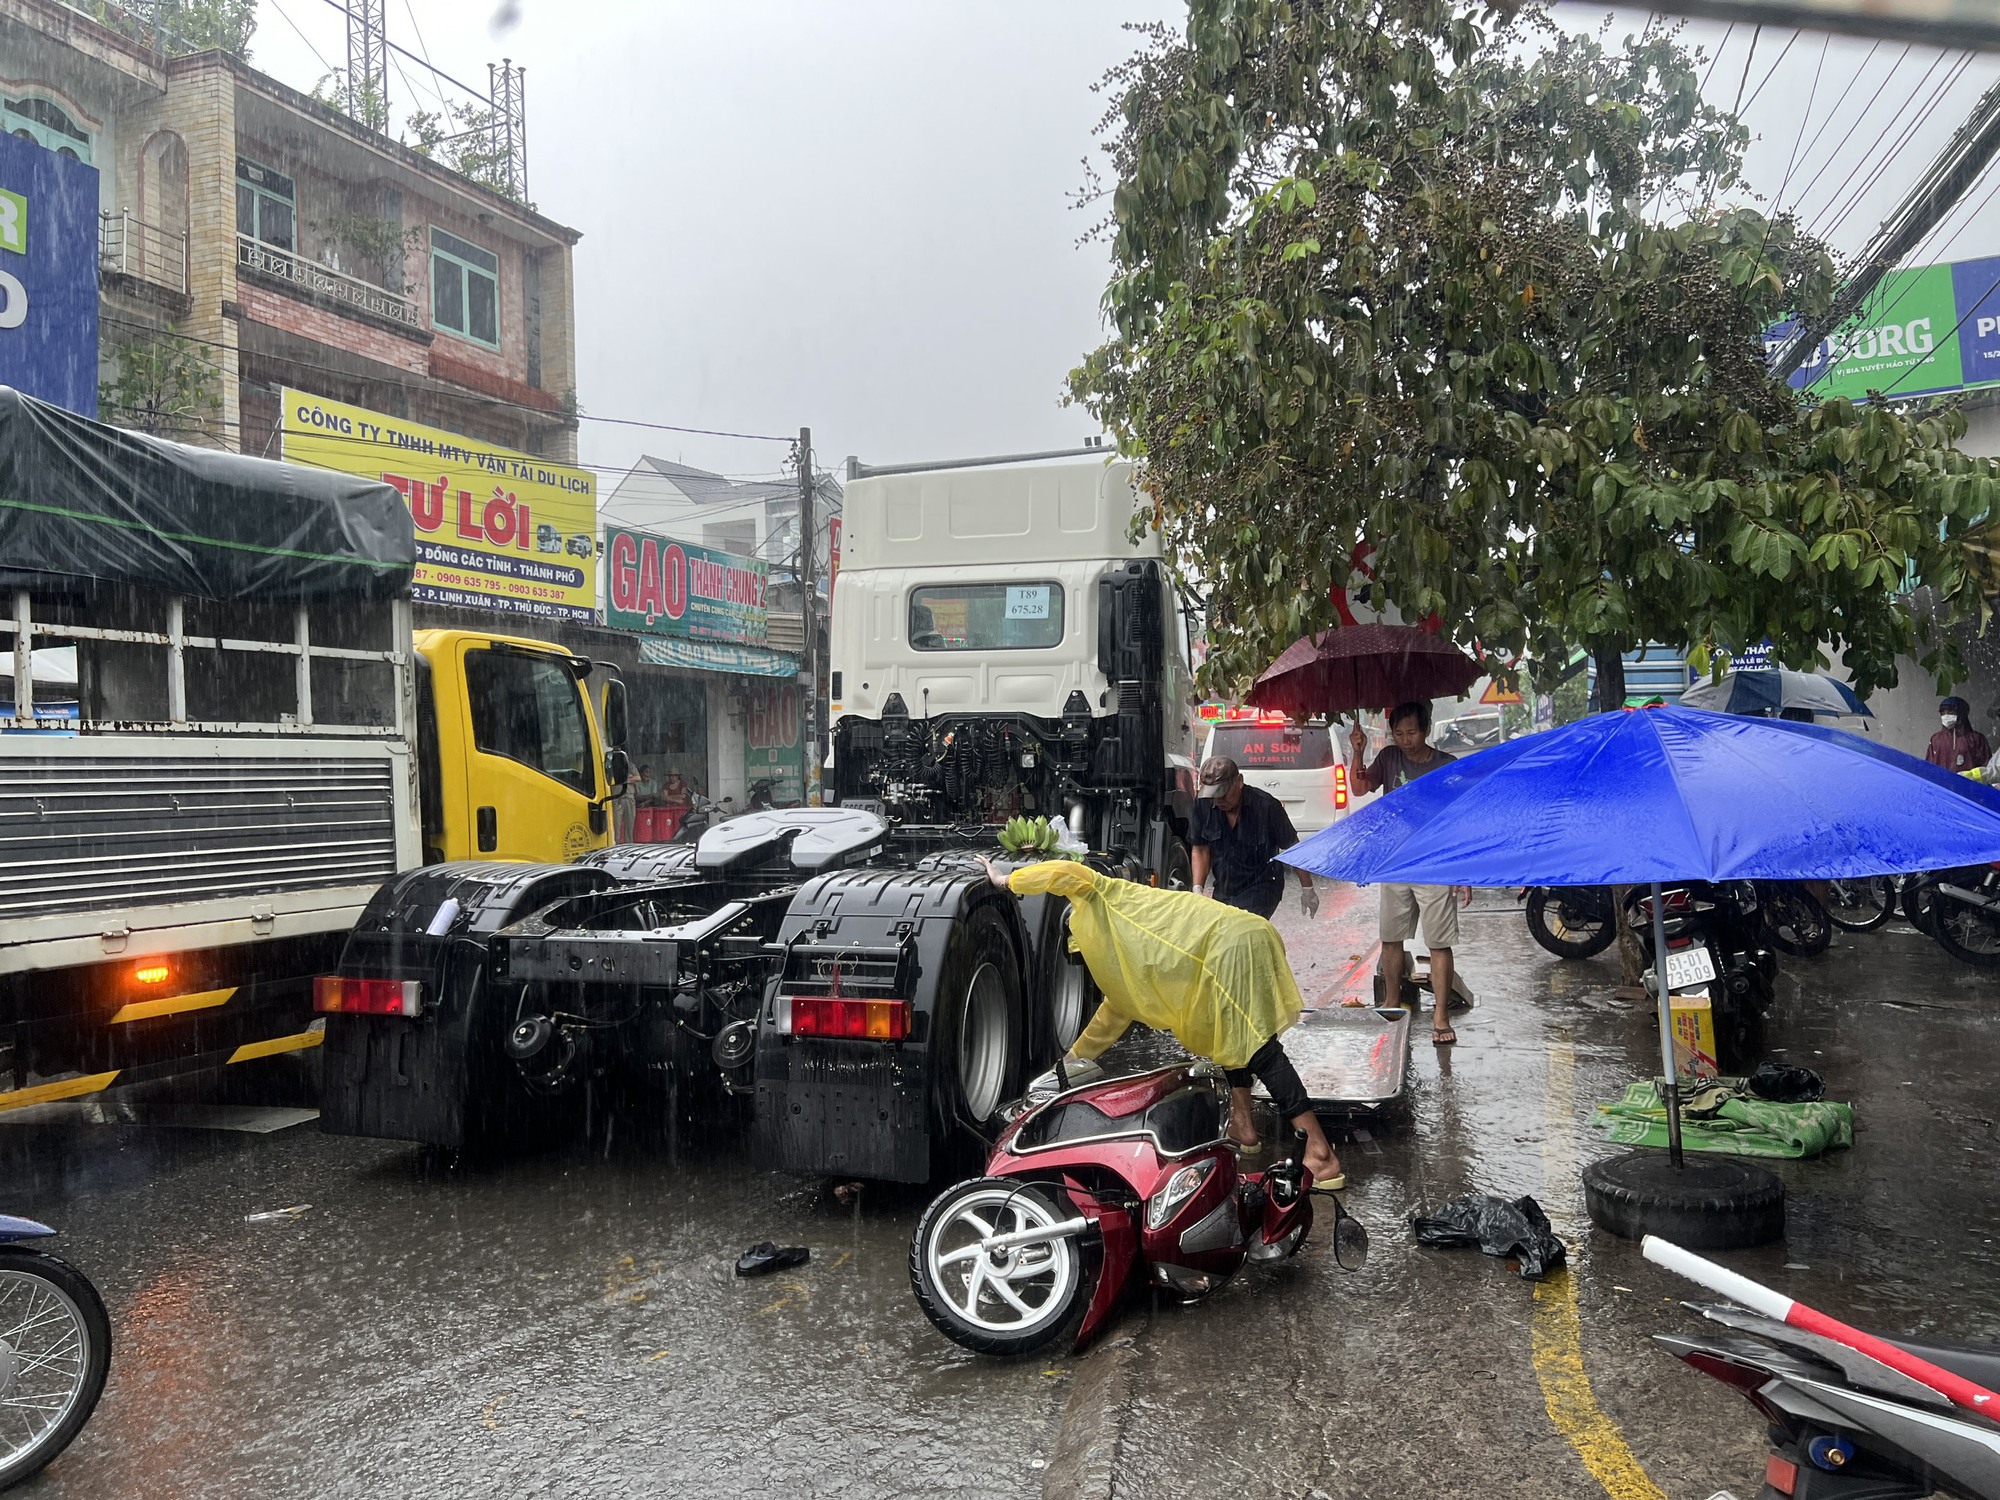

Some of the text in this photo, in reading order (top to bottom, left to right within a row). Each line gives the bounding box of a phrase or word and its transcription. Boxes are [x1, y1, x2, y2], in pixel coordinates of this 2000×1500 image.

[1861, 364, 1885, 372] TUYỆT
[297, 406, 589, 495] CÔNG TY TNHH MTV VẬN TẢI DU LỊCH
[457, 485, 530, 550] LỜI
[425, 545, 458, 564] ĐỒNG
[461, 552, 483, 568] CÁC
[486, 556, 511, 573] TỈNH
[520, 564, 553, 580] THÀNH
[555, 569, 576, 583] PHỐ
[437, 572, 461, 584] 0909
[464, 576, 481, 587] 635
[484, 580, 500, 590] 795
[509, 583, 530, 595] 0903
[532, 587, 548, 597] 635
[550, 590, 565, 600] 387
[611, 532, 687, 625] GẠO
[689, 552, 767, 610] THÀNH CHUNG 2
[428, 590, 437, 600] P.
[440, 591, 463, 603] LINH
[465, 594, 491, 607] XUÂN
[498, 599, 512, 610] TP.
[514, 600, 532, 612] THỦ
[533, 603, 552, 615] ĐỨC
[558, 607, 570, 618] TP.
[572, 609, 589, 620] HCM
[1019, 589, 1038, 600] T89
[1011, 604, 1044, 614] 675.28
[1735, 657, 1746, 665] VÀ
[747, 684, 799, 762] GẠO
[1243, 743, 1265, 754] AN
[1667, 965, 1712, 987] 735.09
[1668, 952, 1702, 972] 61-D1
